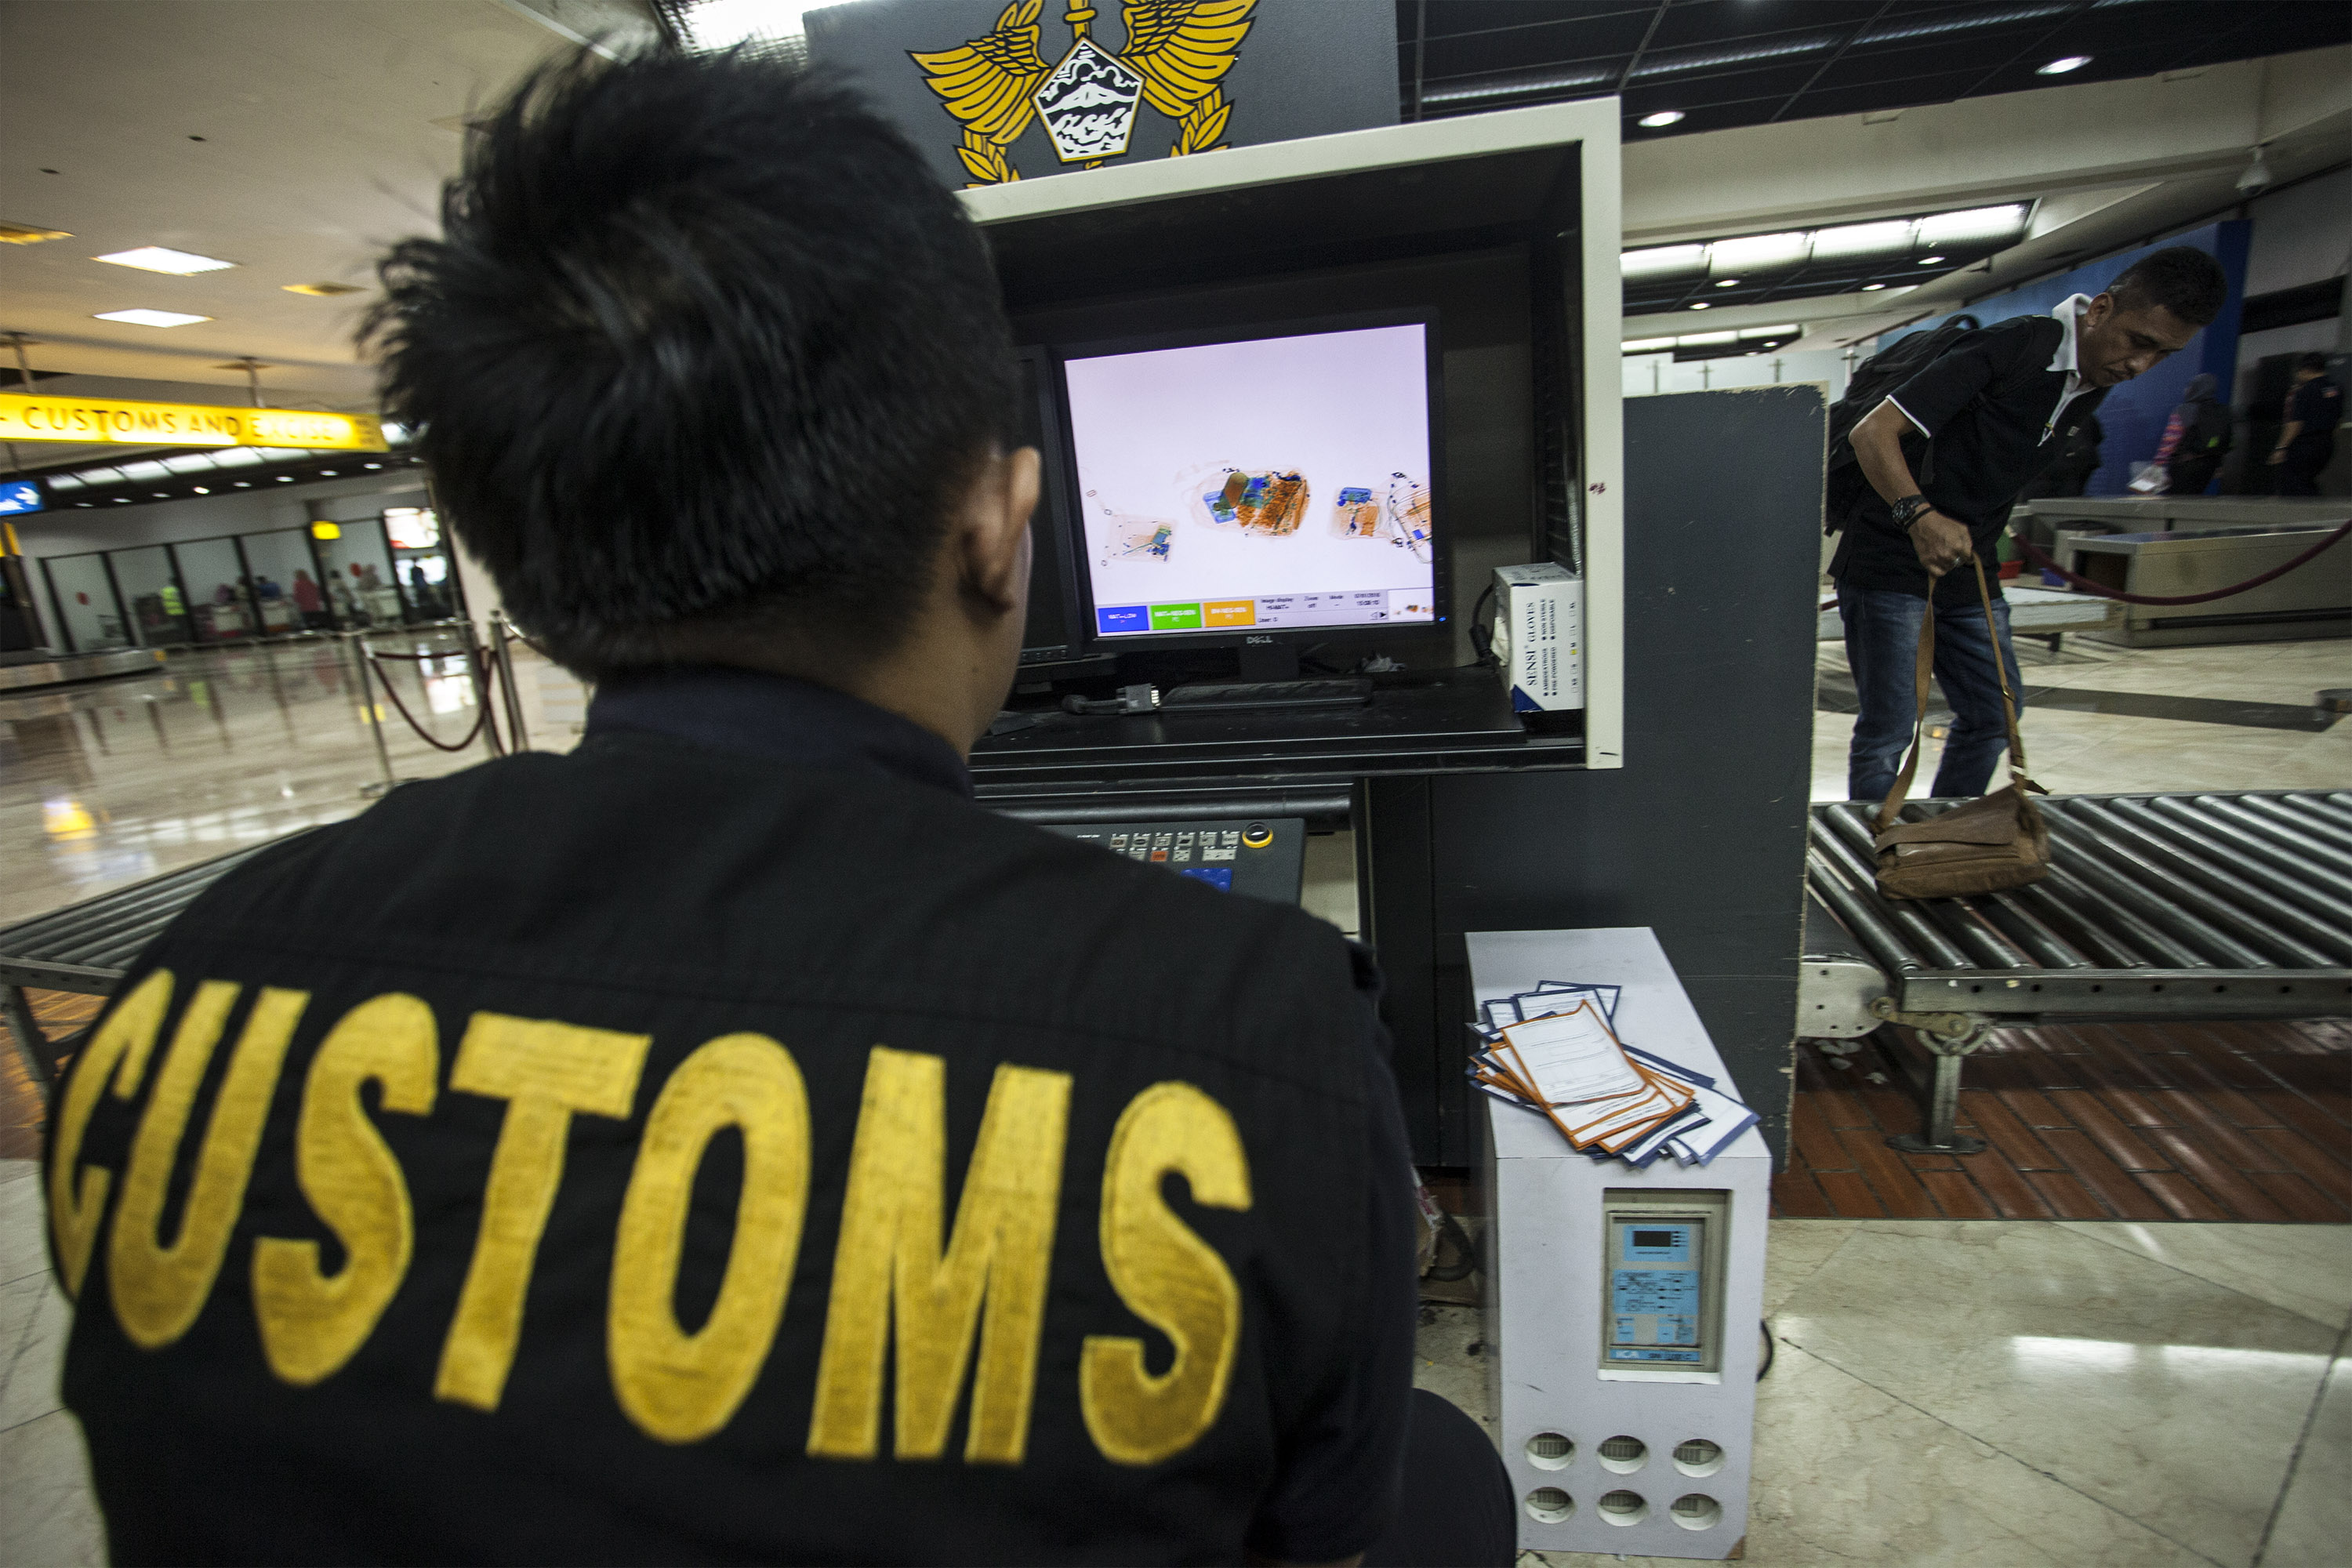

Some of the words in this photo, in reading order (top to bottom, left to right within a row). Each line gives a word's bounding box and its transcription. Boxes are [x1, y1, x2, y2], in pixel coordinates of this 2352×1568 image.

[23, 405, 178, 435] CUSTOMS
[189, 413, 241, 437] AND
[250, 416, 336, 441] EXCISE
[1525, 601, 1537, 643] GLOVES
[1525, 649, 1537, 687] SENSI
[45, 967, 1253, 1464] CUSTOMS
